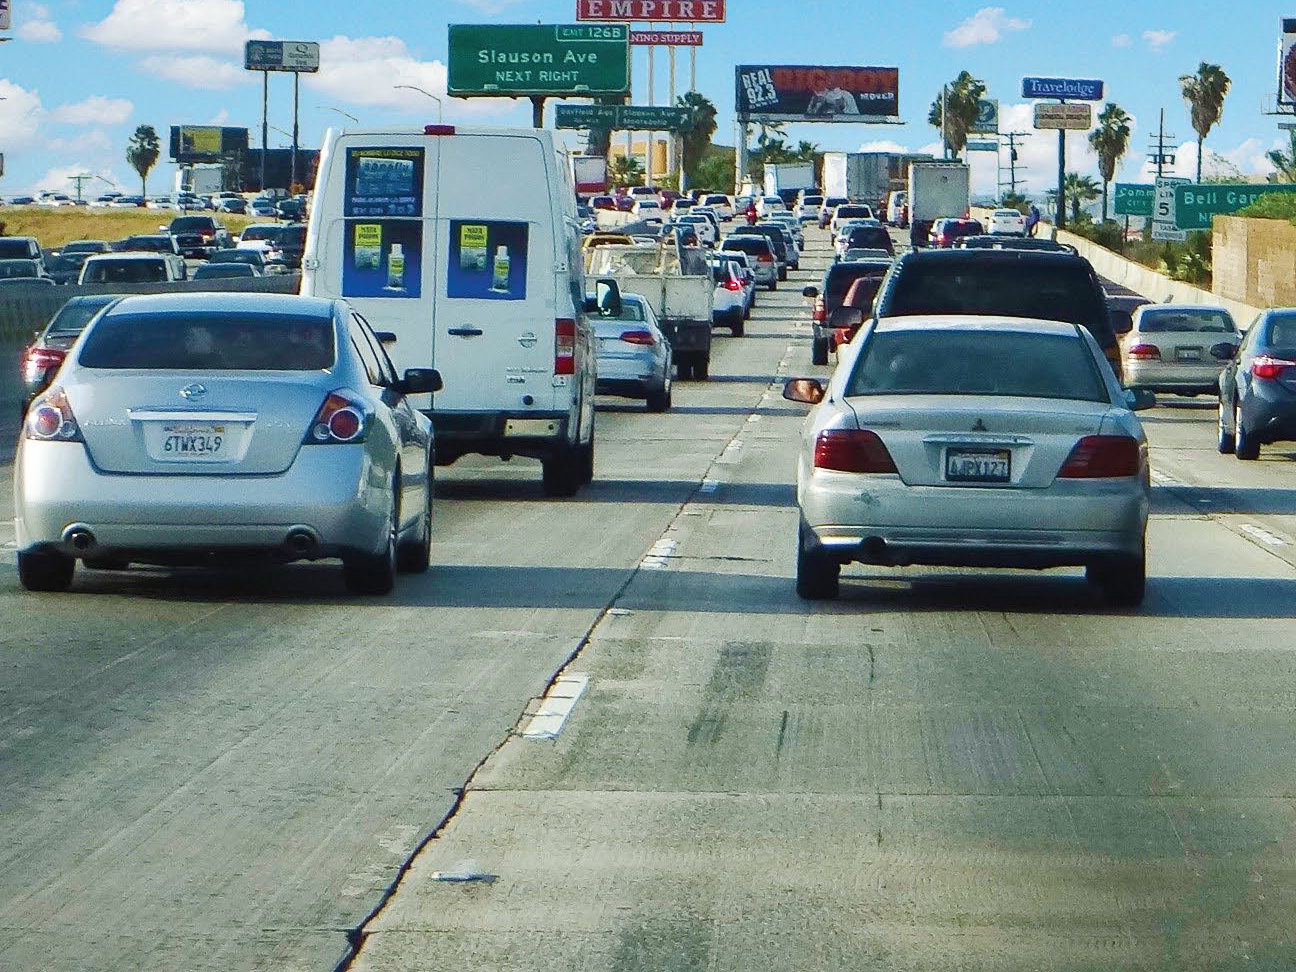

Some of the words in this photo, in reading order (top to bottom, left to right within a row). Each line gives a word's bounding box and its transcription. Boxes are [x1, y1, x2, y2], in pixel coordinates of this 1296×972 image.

[588, 0, 717, 18] EMPIRE
[563, 29, 583, 37] EXIT
[588, 28, 621, 38] 126B
[631, 34, 658, 43] NING
[660, 34, 700, 43] SUPPLY
[478, 50, 553, 64] Slauson
[563, 50, 598, 64] Ave
[496, 71, 532, 82] NEXT
[539, 71, 579, 82] RIGHT
[741, 68, 774, 89] REAL
[746, 84, 778, 105] 92.3
[1029, 79, 1095, 96] Travelodge
[1183, 191, 1217, 204] Bell
[164, 435, 222, 453] 6TWX349
